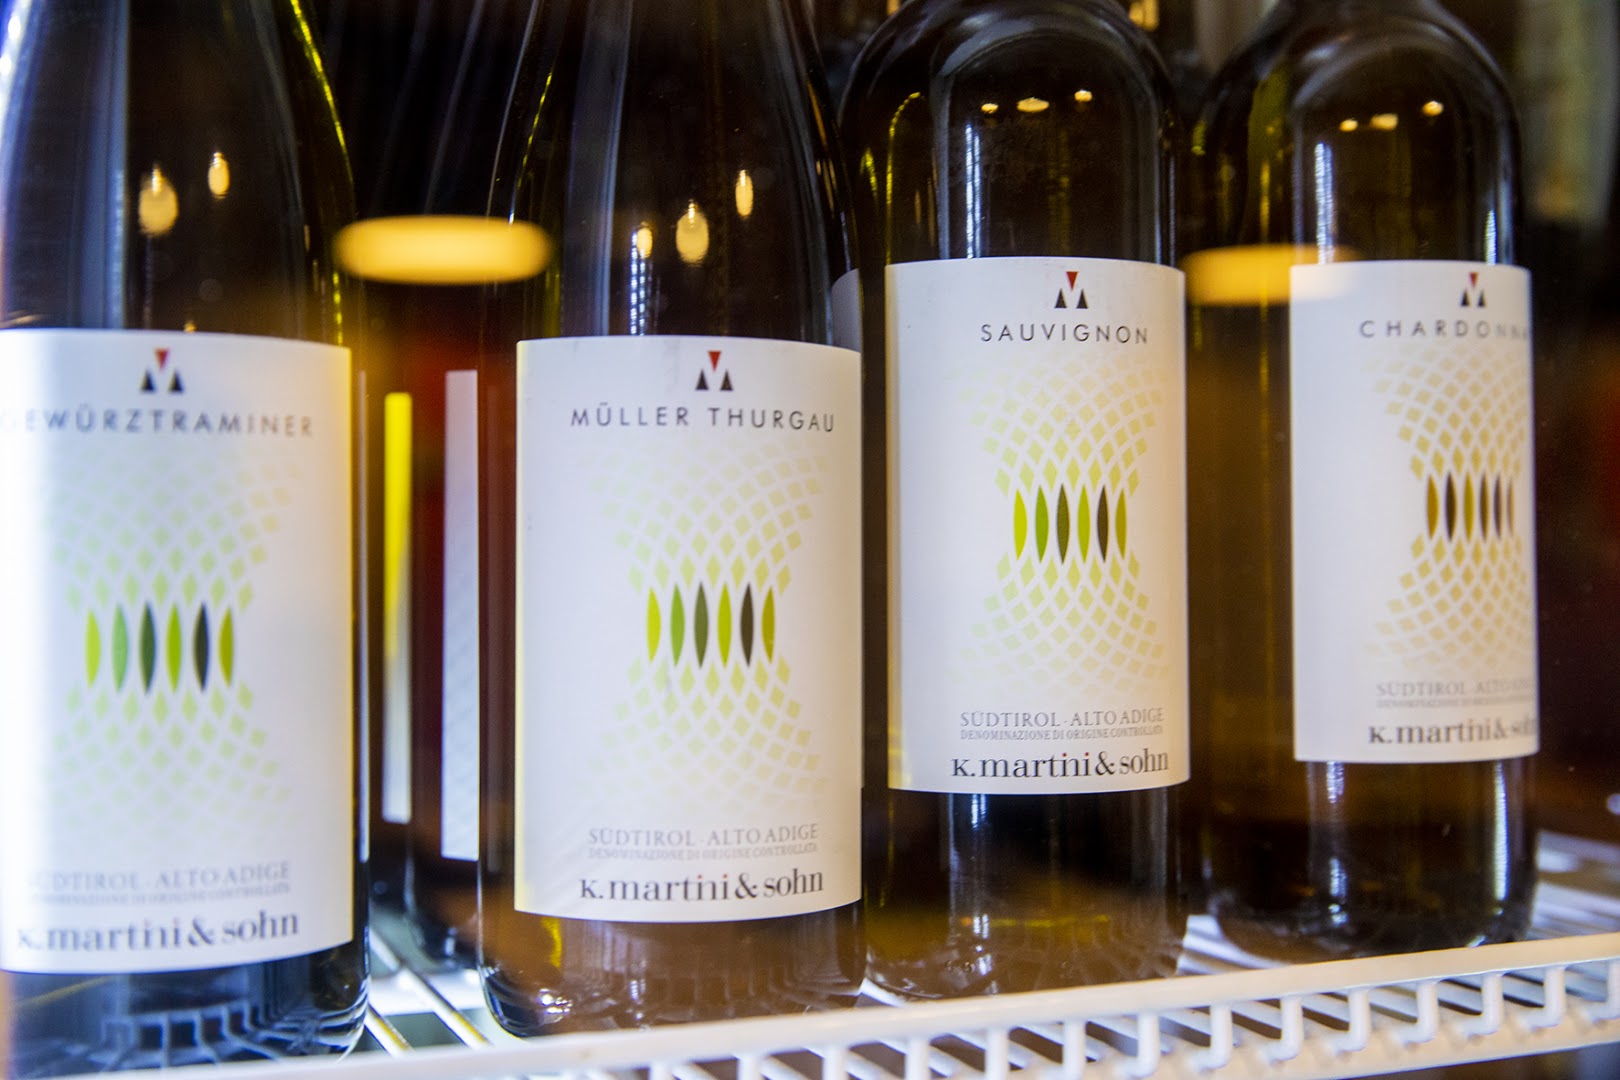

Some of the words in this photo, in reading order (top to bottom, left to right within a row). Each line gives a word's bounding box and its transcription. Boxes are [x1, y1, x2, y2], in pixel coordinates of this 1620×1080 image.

[979, 323, 1148, 344] SAUVIGNON
[570, 401, 690, 427] MÜLLER
[707, 406, 835, 432] THURGAU
[959, 710, 1061, 728] SÜDTIROL
[1069, 709, 1117, 727] ALTO
[1119, 707, 1165, 725] ADIGE
[959, 729, 1051, 741] DENOMINAZIONE
[1052, 729, 1065, 740] DI
[587, 825, 697, 847] SÜDTIROL
[706, 827, 762, 846] ALTO
[764, 823, 819, 843] ADIGE
